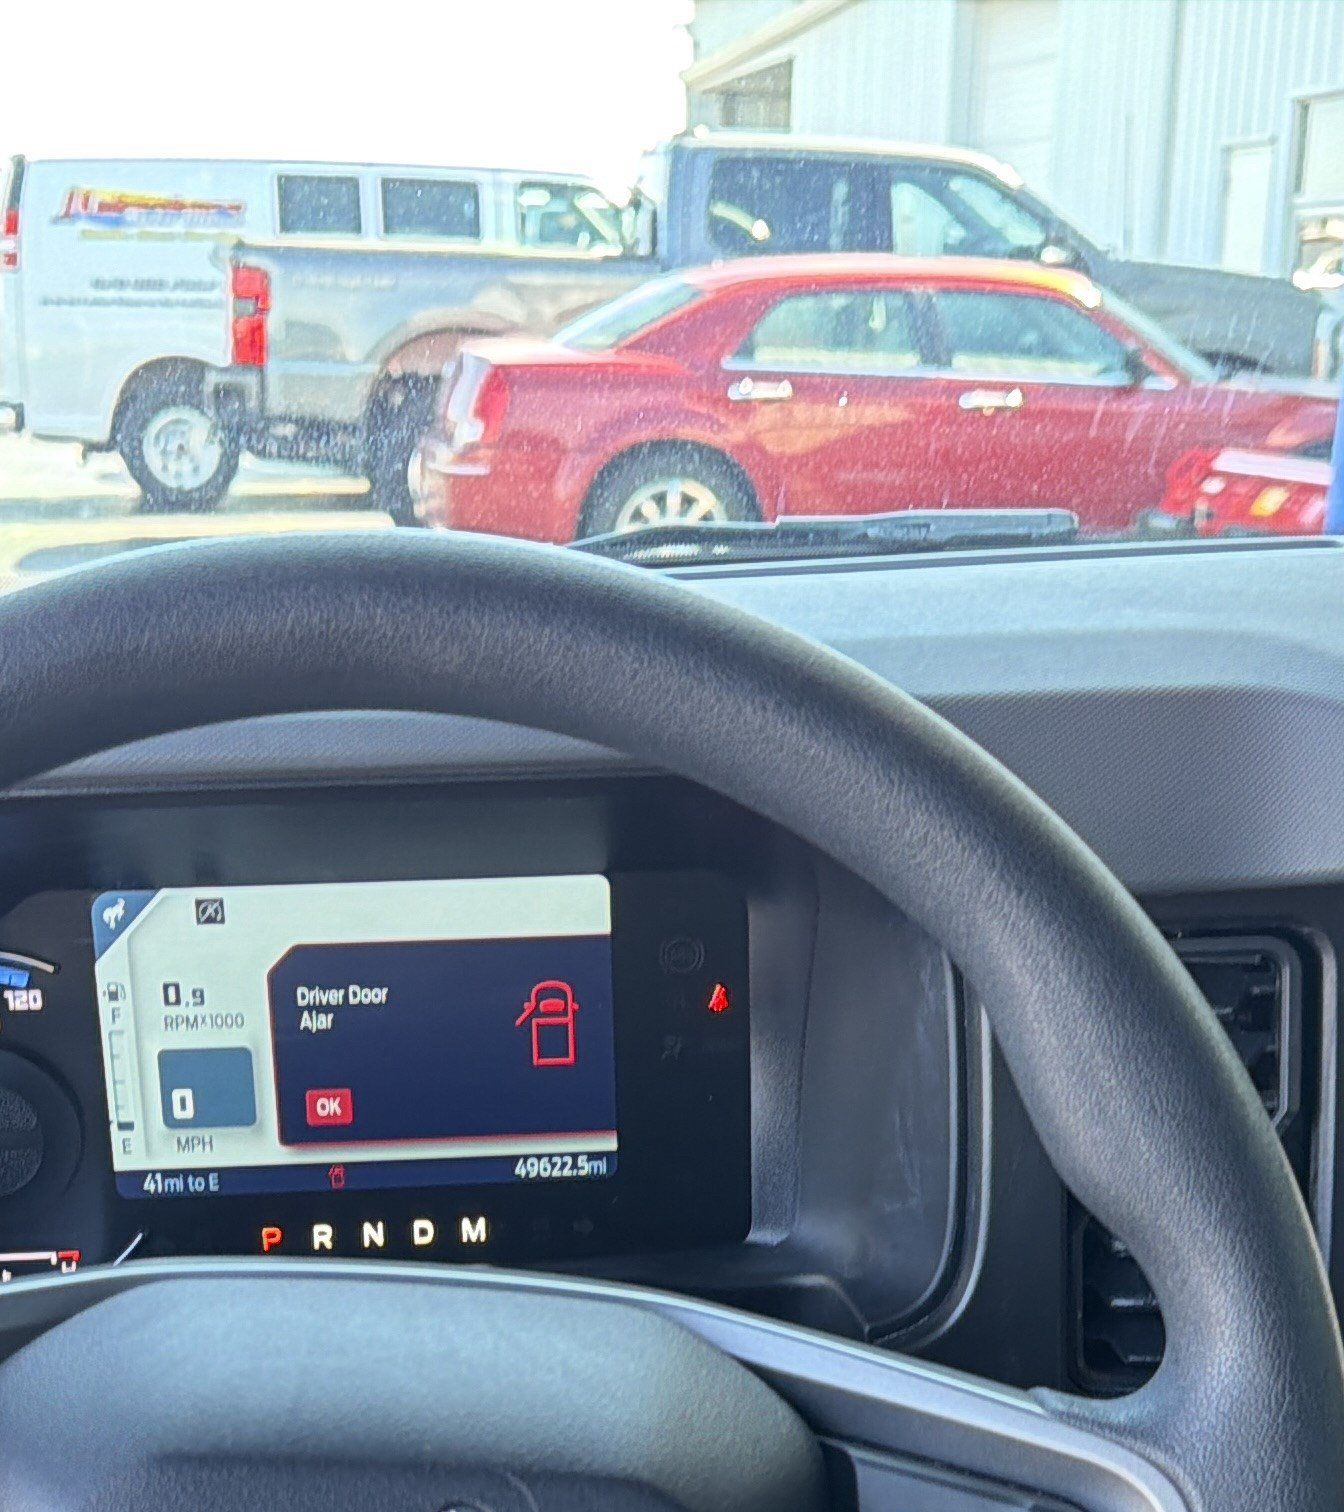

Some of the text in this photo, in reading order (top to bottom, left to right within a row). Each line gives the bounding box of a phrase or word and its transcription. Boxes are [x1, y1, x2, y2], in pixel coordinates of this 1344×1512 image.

[4, 988, 43, 1011] 120
[296, 984, 389, 1007] Driver Door
[111, 1007, 121, 1025] F
[299, 1011, 334, 1033] Ajar
[172, 1088, 195, 1119] 0
[316, 1097, 342, 1117] OK
[122, 1138, 132, 1155] E
[176, 1135, 214, 1153] MPH
[513, 1153, 608, 1180] 49622.5mi
[143, 1172, 219, 1194] 41mi to E
[261, 1216, 486, 1252] P R N D M
